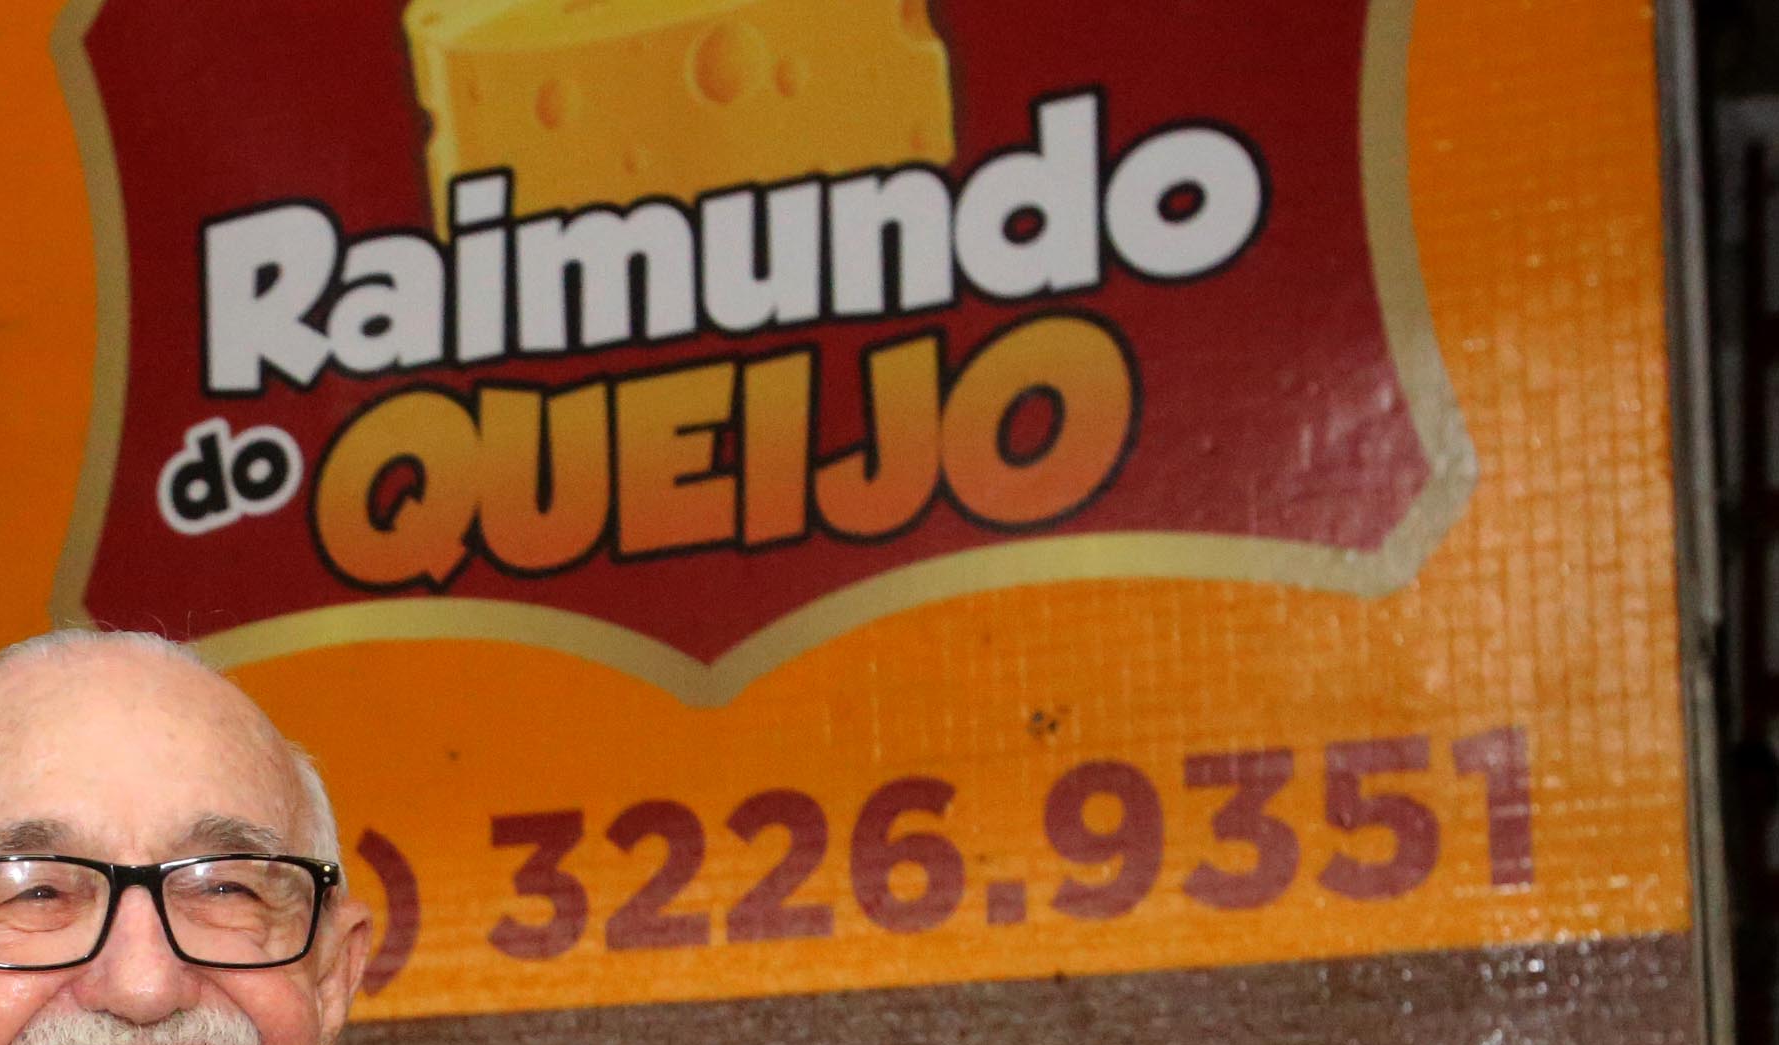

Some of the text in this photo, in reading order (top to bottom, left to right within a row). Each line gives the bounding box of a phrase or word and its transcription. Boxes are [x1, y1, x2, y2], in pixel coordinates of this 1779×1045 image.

[202, 90, 1265, 392] Raimundo
[164, 312, 1139, 592] do QUEIJO
[487, 726, 1533, 960] 3226.9351
